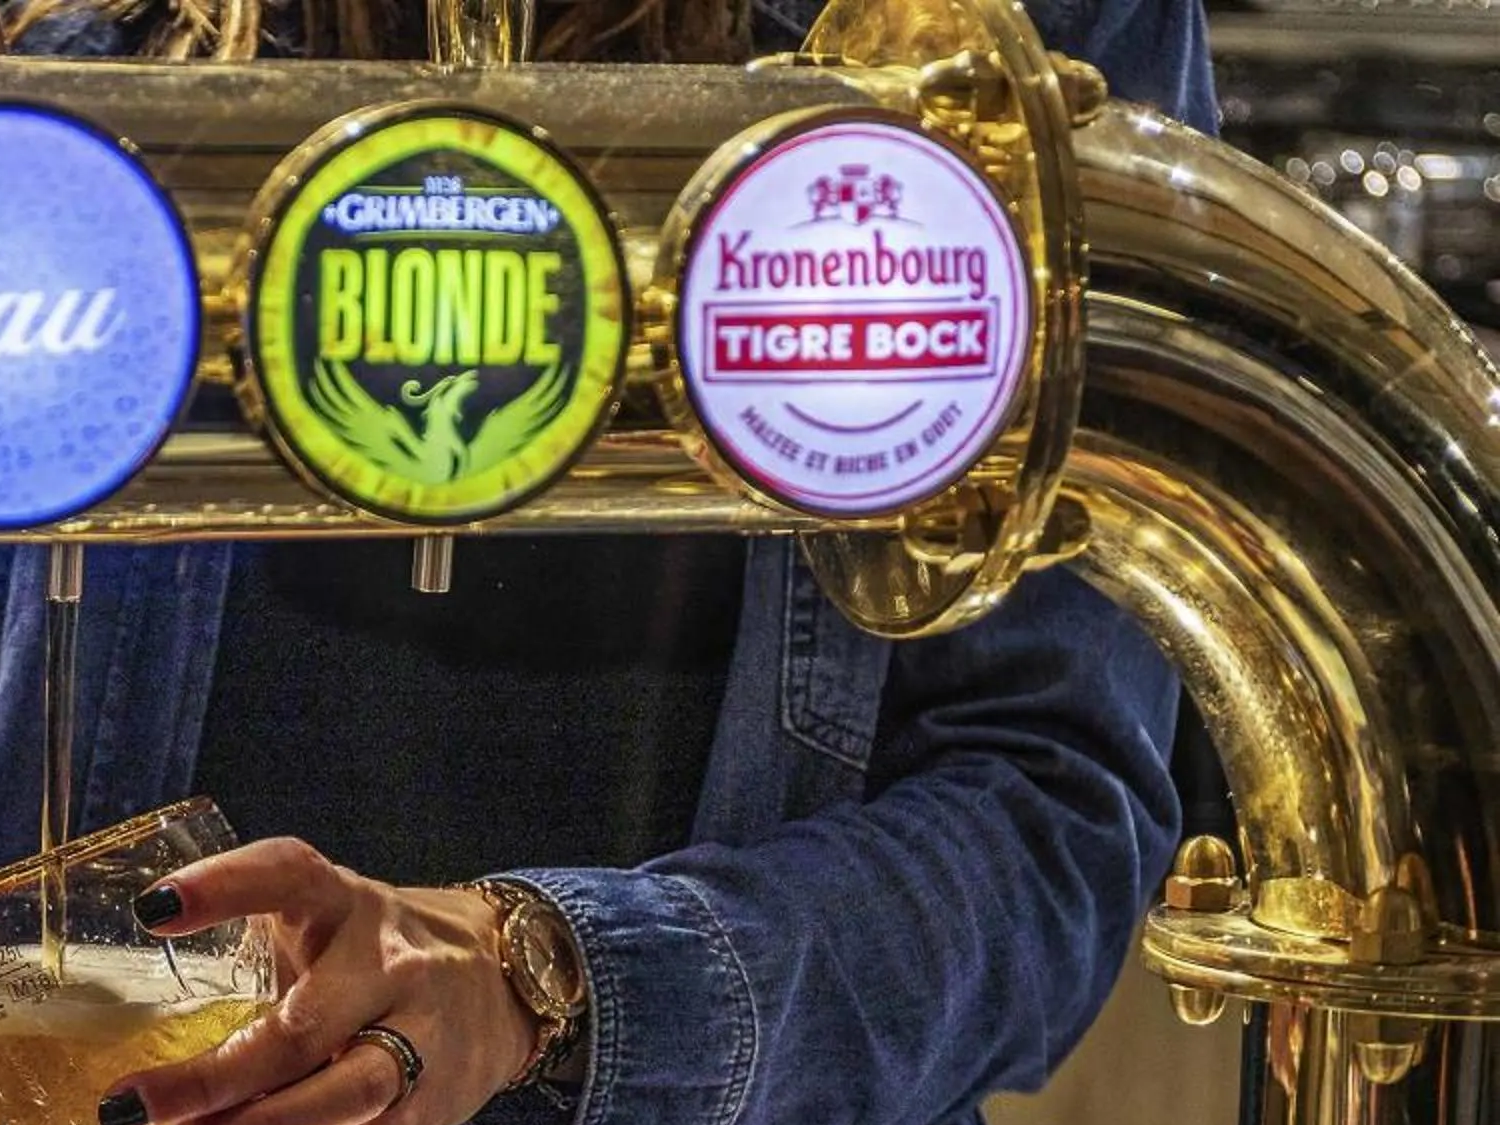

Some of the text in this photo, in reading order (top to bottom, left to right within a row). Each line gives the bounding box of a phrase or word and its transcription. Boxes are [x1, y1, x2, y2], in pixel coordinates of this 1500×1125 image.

[336, 193, 549, 232] GRIMBERGEN
[714, 229, 988, 300] Kronenbourg
[320, 247, 563, 366] BLONDE
[717, 319, 985, 362] TIGRE BOCK
